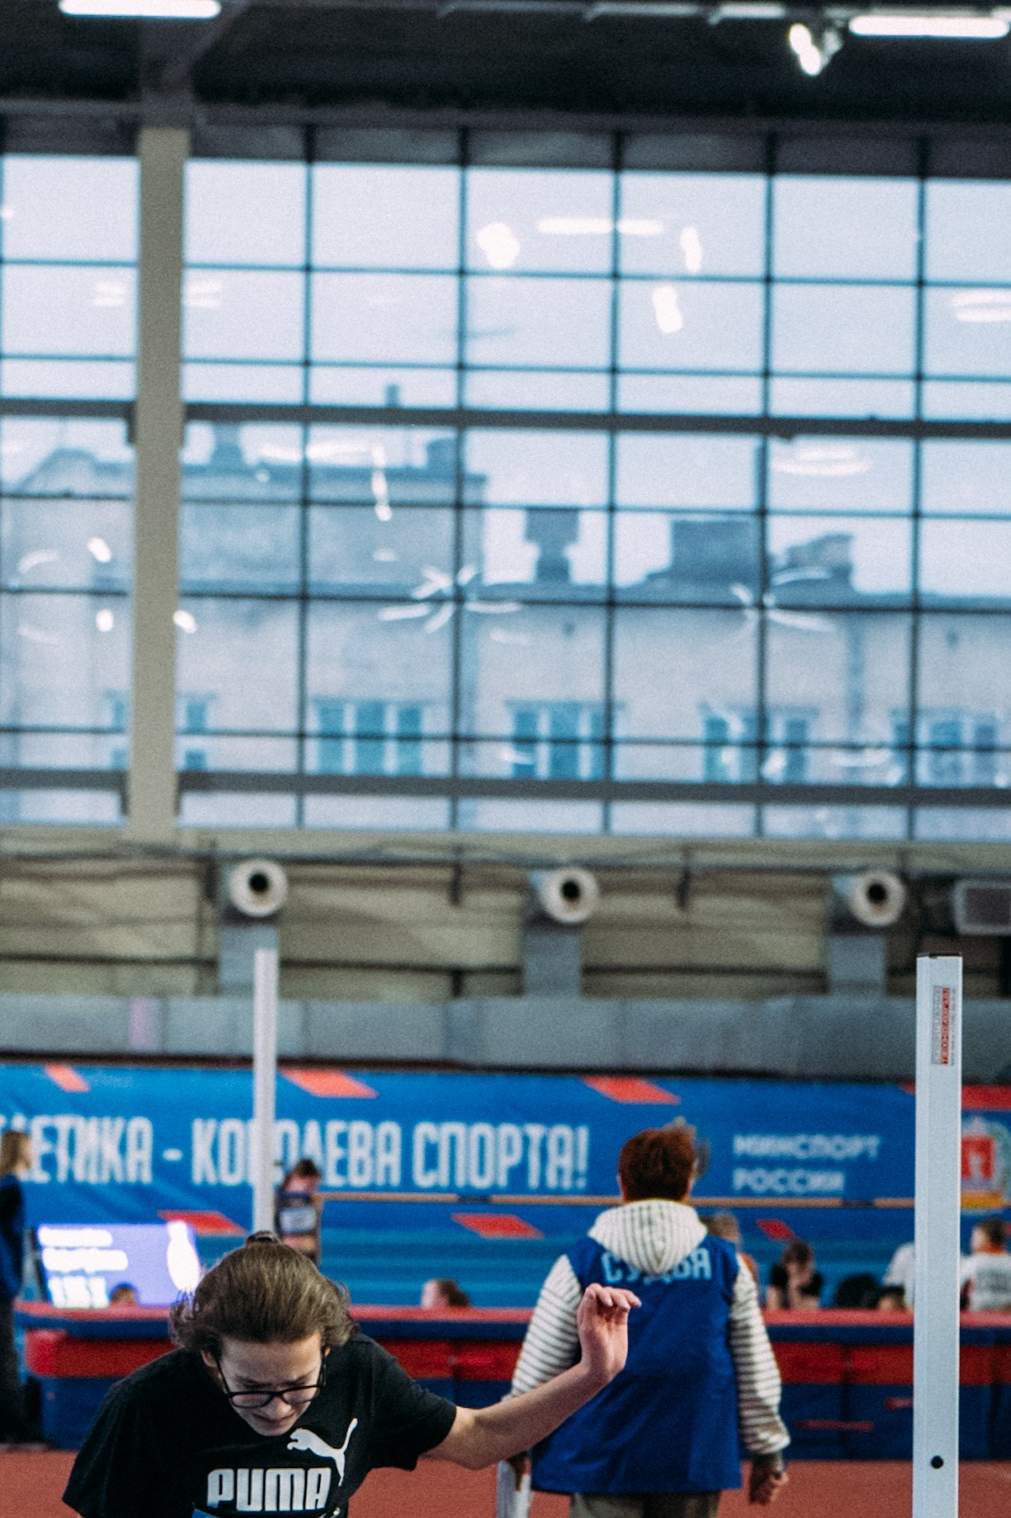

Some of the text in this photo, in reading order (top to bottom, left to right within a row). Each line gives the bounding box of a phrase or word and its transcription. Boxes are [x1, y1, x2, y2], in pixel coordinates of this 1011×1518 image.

[413, 1121, 589, 1189] СПОРТА!
[732, 1168, 845, 1194] РОССИИ
[207, 1467, 331, 1512] PUMA
